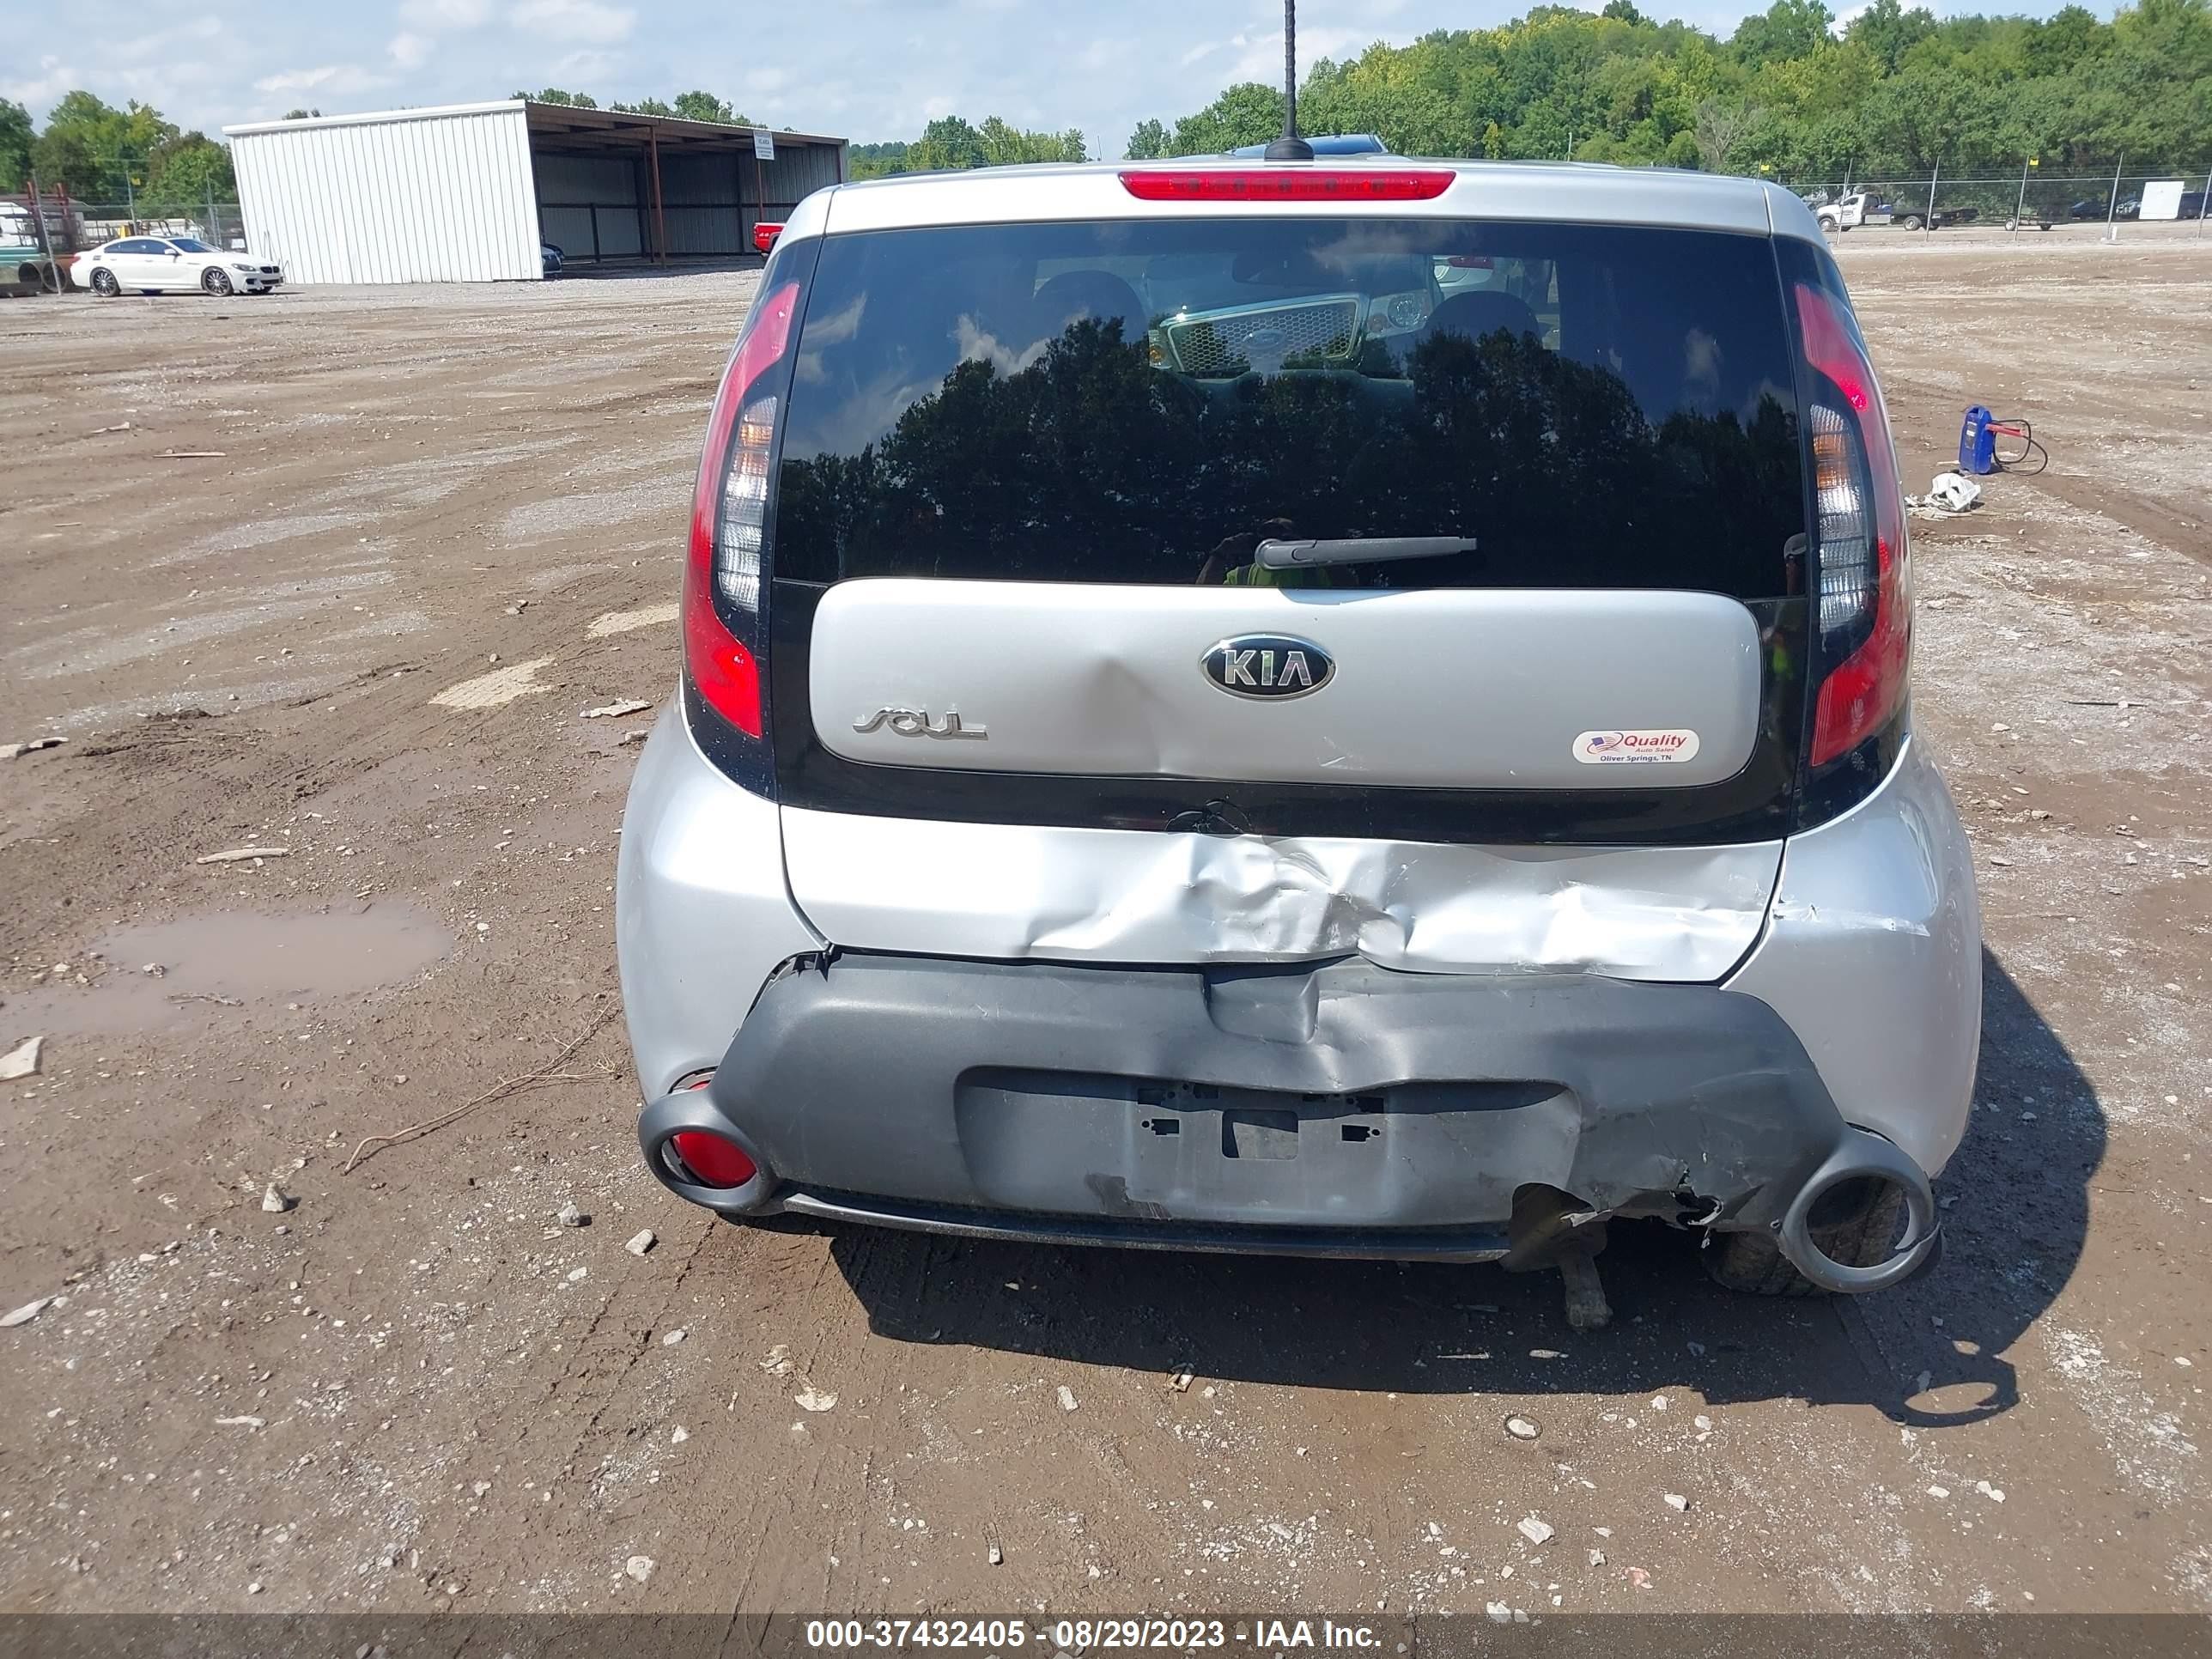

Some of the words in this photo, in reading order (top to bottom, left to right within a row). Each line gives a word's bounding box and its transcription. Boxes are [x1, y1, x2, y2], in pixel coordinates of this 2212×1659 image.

[1224, 649, 1313, 686] KIA
[853, 705, 988, 741] SOUL
[1625, 734, 1687, 748] Quality
